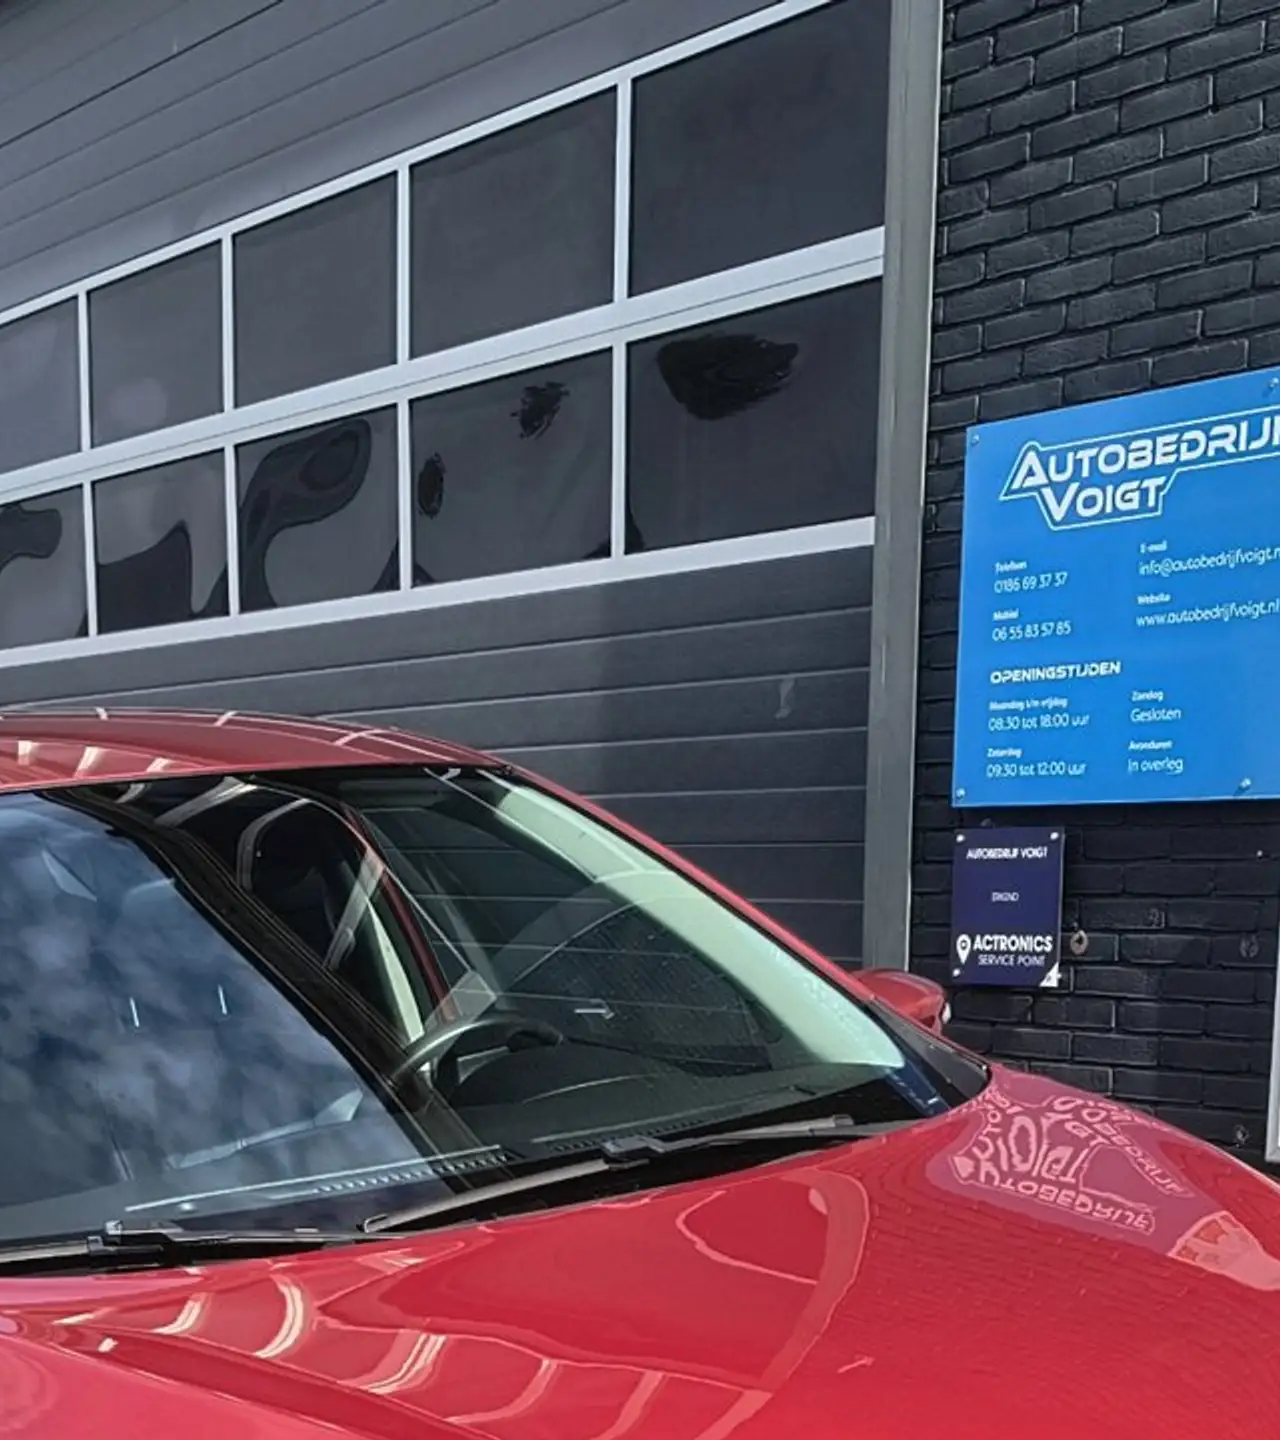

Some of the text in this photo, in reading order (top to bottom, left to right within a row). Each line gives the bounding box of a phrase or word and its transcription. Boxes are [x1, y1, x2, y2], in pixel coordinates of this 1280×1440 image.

[1041, 475, 1168, 522] VOIGT
[1136, 598, 1280, 627] www.autobedrijfvoigt.nl
[990, 660, 1121, 684] OPENINGSTIJDEN
[1021, 715, 1038, 729] tot
[1071, 714, 1090, 726] uur
[1130, 707, 1182, 722] Gesloten
[1019, 762, 1035, 776] tot
[1067, 763, 1086, 775] uur
[1140, 756, 1183, 775] overleg
[1020, 846, 1048, 859] VOIGT
[973, 934, 1053, 952] ACTRONICS
[978, 954, 1046, 966] SERVICE POINT
